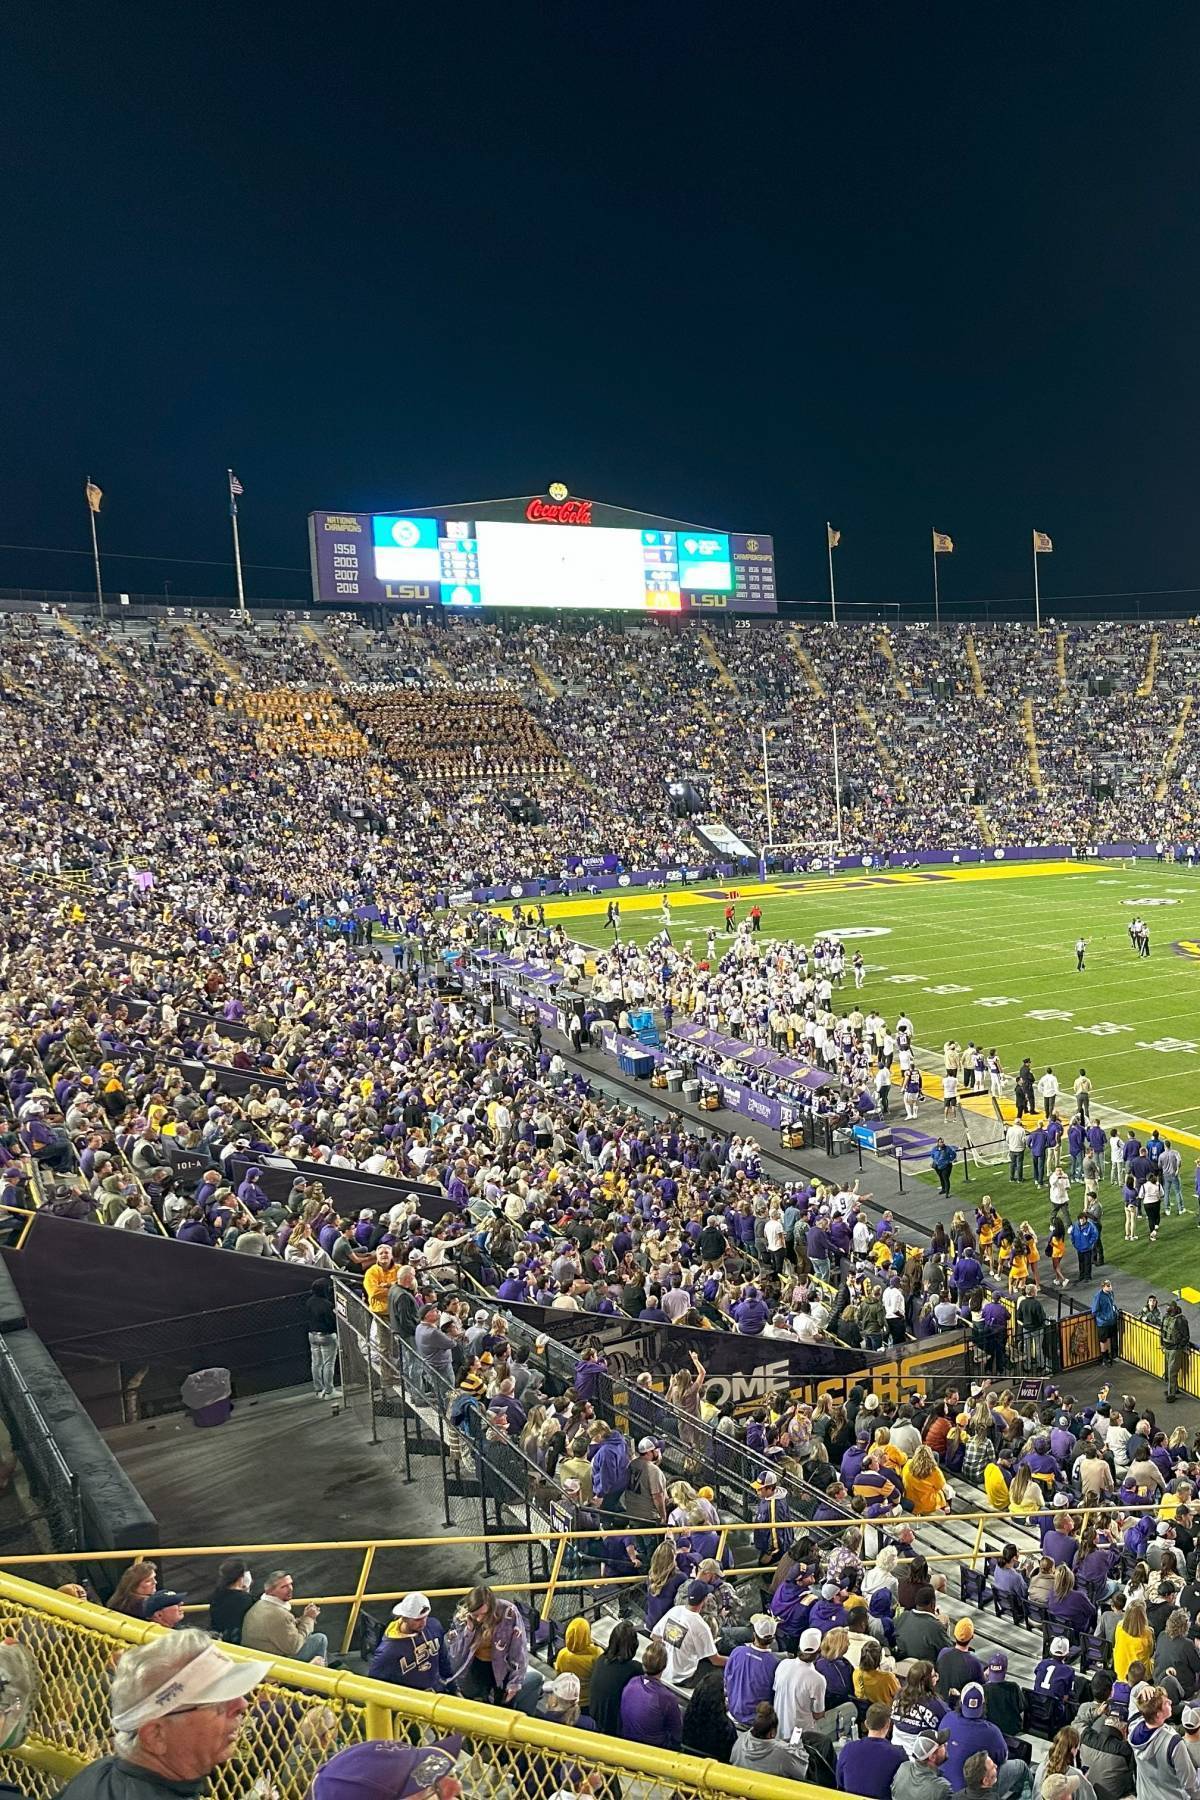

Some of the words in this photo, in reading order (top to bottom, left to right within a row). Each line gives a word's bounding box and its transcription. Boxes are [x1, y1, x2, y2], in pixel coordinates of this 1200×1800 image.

[527, 499, 592, 524] Coca-Cola
[334, 544, 356, 554] 1958
[334, 556, 358, 567] 2003
[335, 569, 358, 580] 2007
[337, 582, 359, 593] 2019
[386, 585, 429, 598] LSU
[690, 594, 726, 607] LSU
[736, 620, 751, 629] 235
[914, 622, 930, 631] 237
[177, 1160, 201, 1170] 101-A
[839, 1197, 847, 1210] 9
[400, 1638, 440, 1674] LSU
[1041, 1665, 1056, 1690] 1
